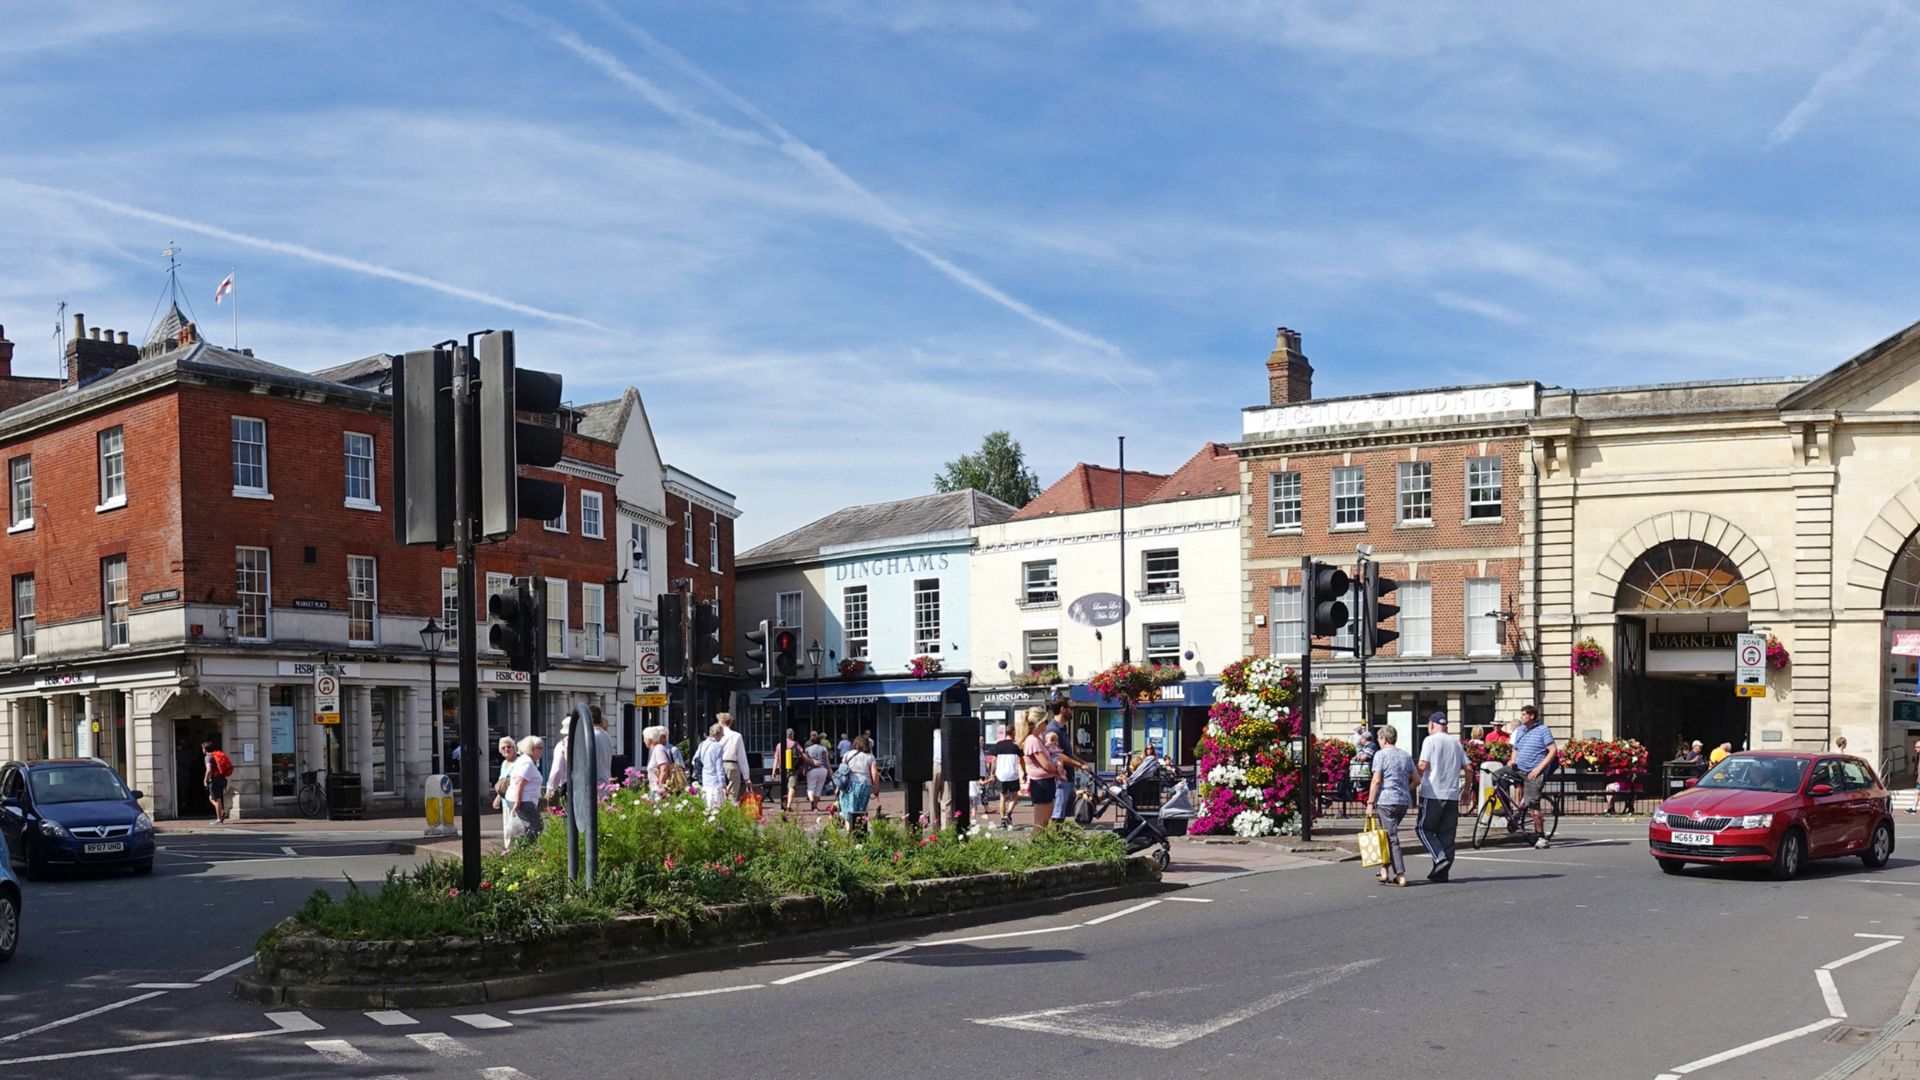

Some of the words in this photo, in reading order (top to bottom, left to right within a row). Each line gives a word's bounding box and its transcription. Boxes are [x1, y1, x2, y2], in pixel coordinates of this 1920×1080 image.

[836, 552, 949, 580] DINGHAMS
[1655, 634, 1717, 648] MARKET
[495, 671, 515, 680] HSBC
[1161, 685, 1185, 699] HILL
[1674, 833, 1693, 842] HG65
[1695, 834, 1710, 843] XPS
